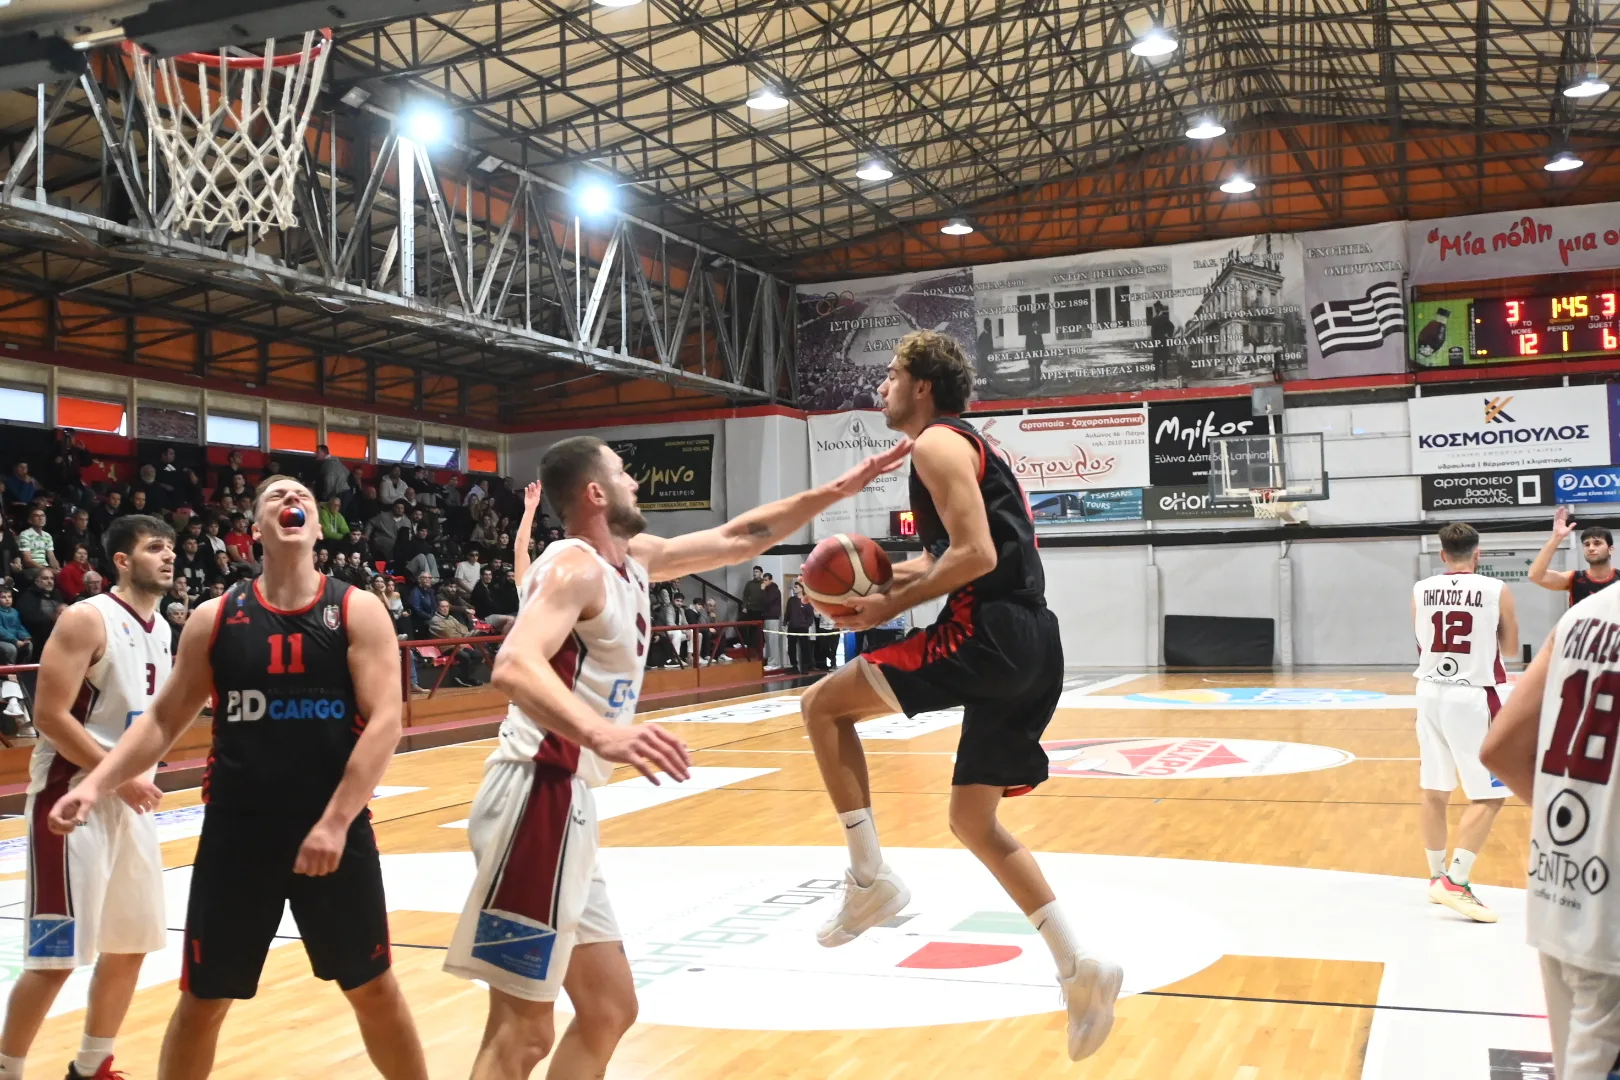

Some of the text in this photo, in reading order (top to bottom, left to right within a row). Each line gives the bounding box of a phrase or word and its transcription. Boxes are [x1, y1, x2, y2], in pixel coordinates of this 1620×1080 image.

[1307, 243, 1373, 258] ΕΝΟΤΗΤΑ
[1324, 260, 1403, 276] ΟΜΟΨΥΧΙΑ
[1069, 299, 1089, 308] 1896
[1505, 301, 1519, 323] 3
[1601, 293, 1615, 316] 3
[829, 315, 900, 332] ΙΣΤΟΡΙΚΕΣ
[1519, 333, 1538, 355] 12
[1135, 363, 1156, 373] 1896
[1419, 424, 1590, 449] ΚΟΣΜΟΠΟΥΛΟΣ
[1155, 454, 1185, 464] Ξύλινα
[1086, 501, 1111, 510] TOURS
[1424, 589, 1462, 607] ΠΗΓΑΣΟΣ
[1431, 611, 1473, 654] 12
[267, 632, 305, 674] 11
[269, 698, 345, 720] CARGO
[1541, 669, 1620, 785] 18
